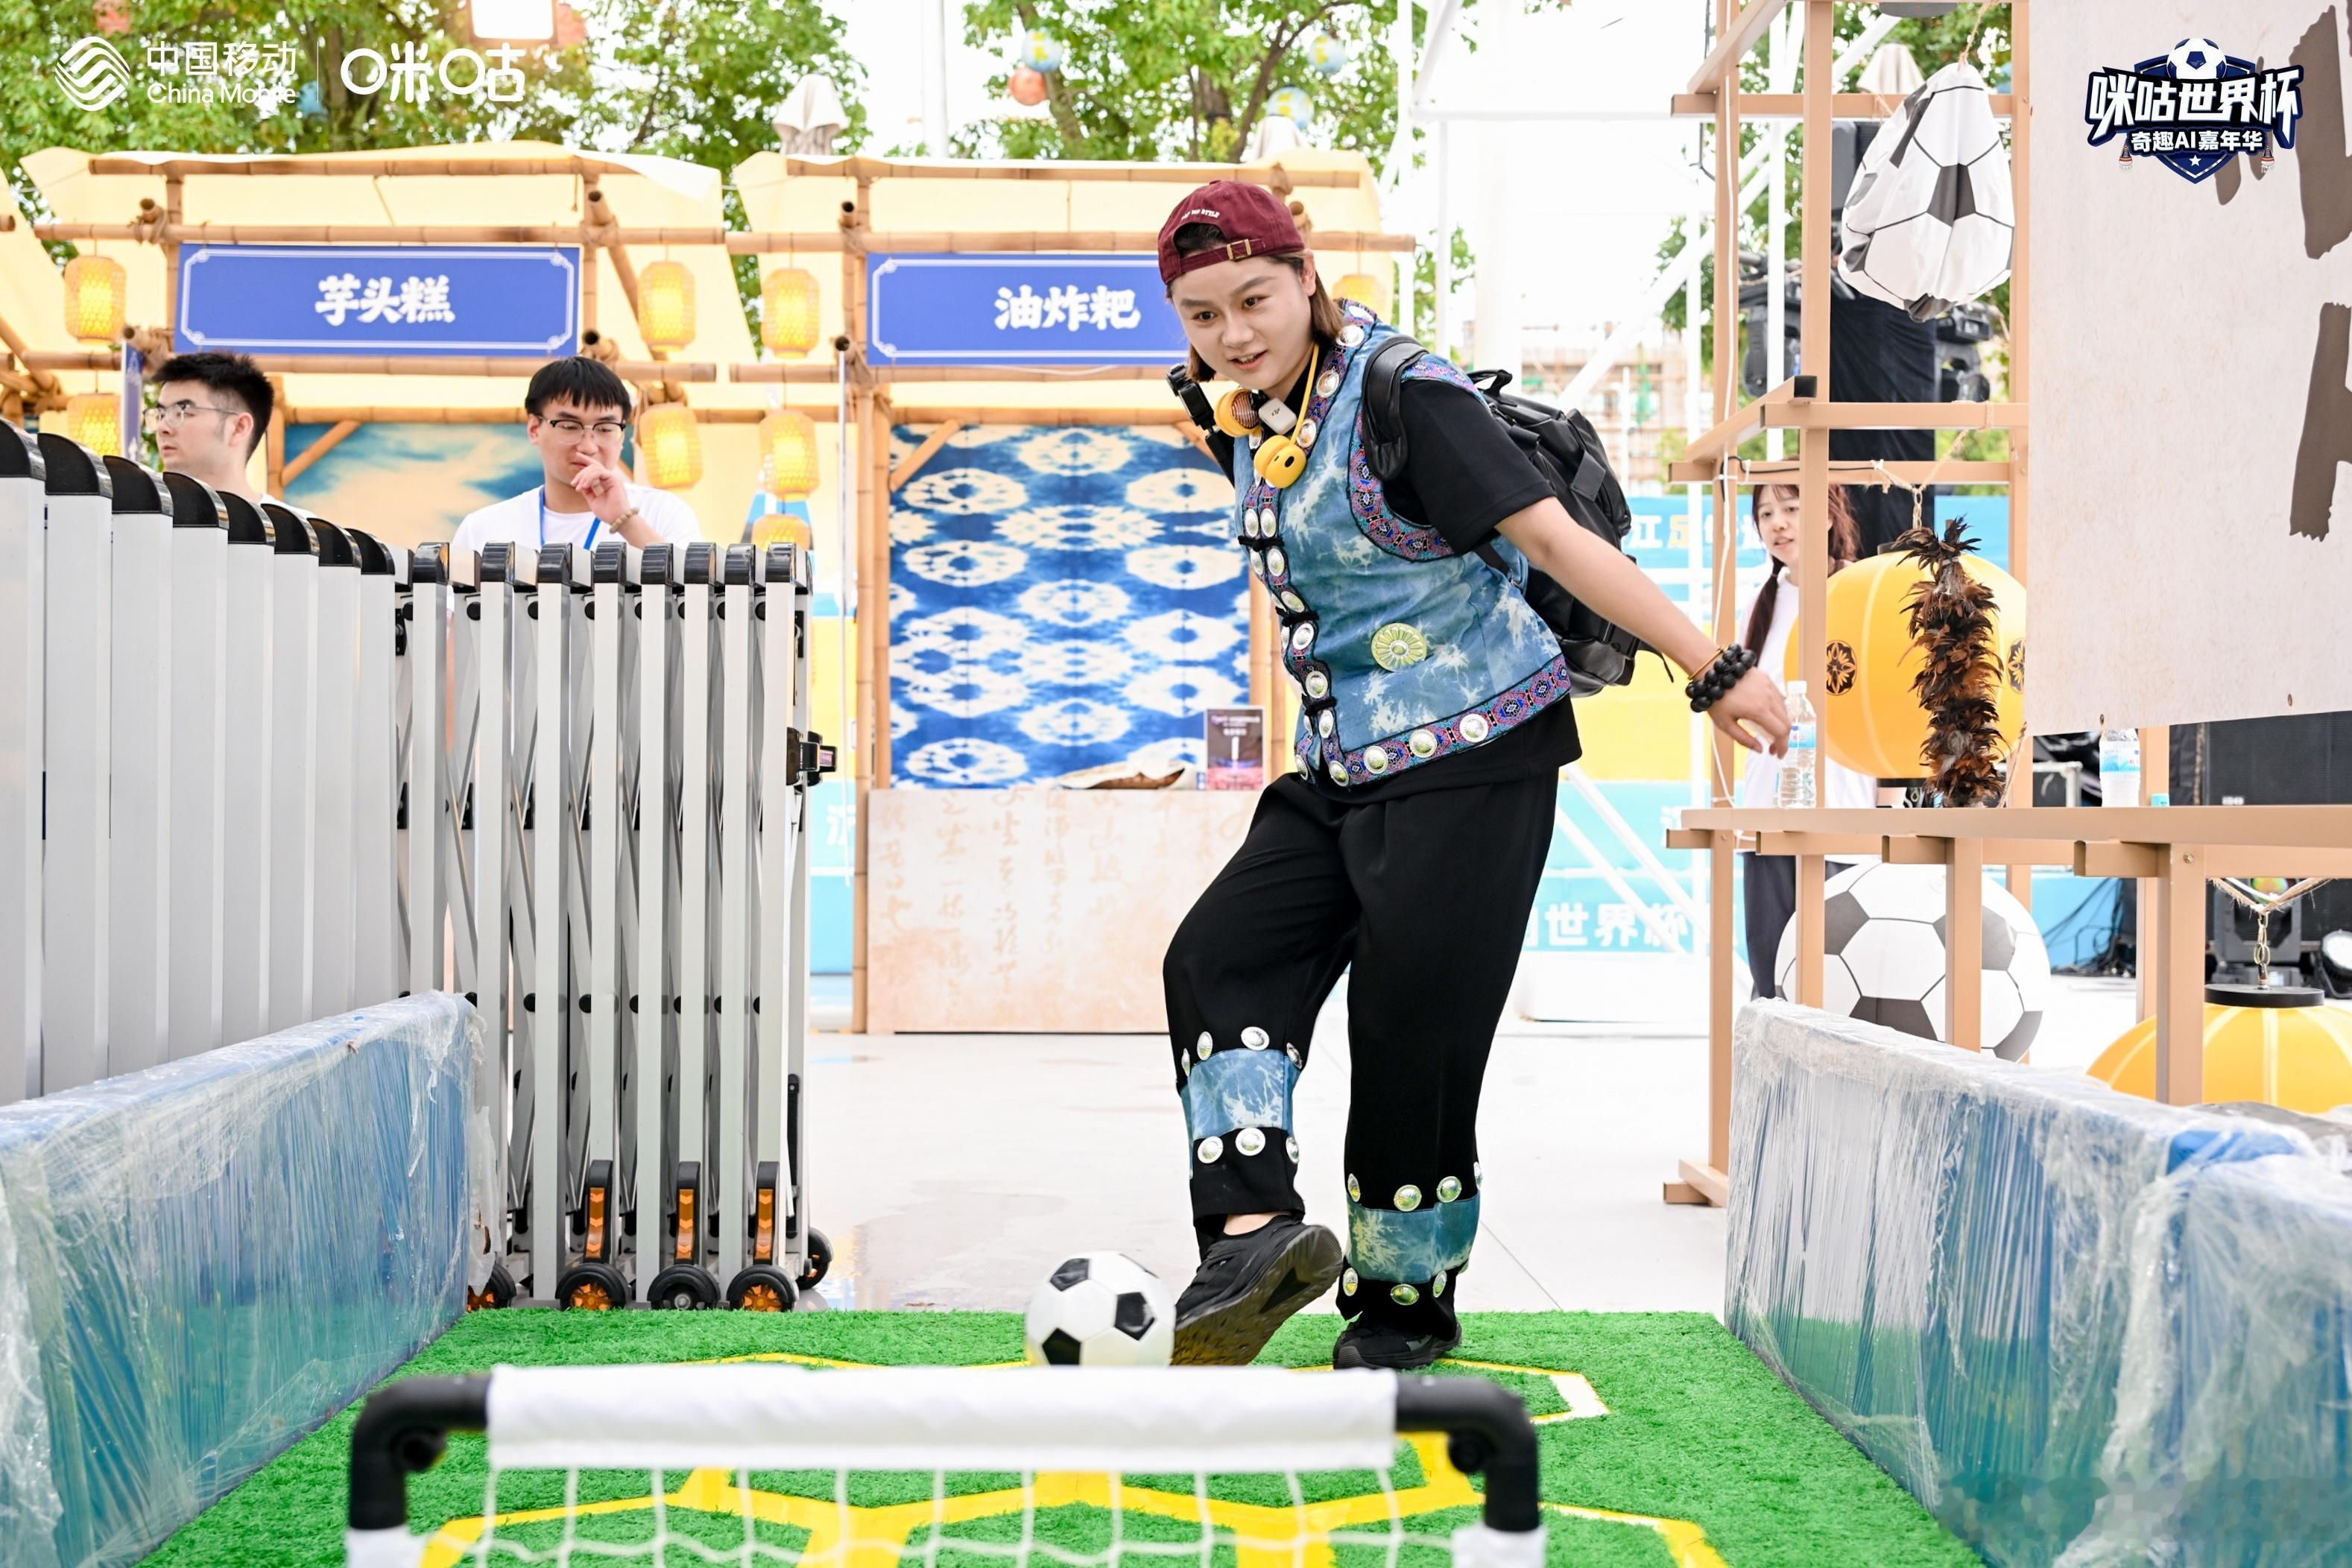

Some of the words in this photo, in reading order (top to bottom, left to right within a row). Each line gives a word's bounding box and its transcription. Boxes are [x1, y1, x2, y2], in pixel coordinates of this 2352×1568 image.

[314, 273, 456, 326] 芋头糕
[994, 284, 1142, 332] 油炸粑
